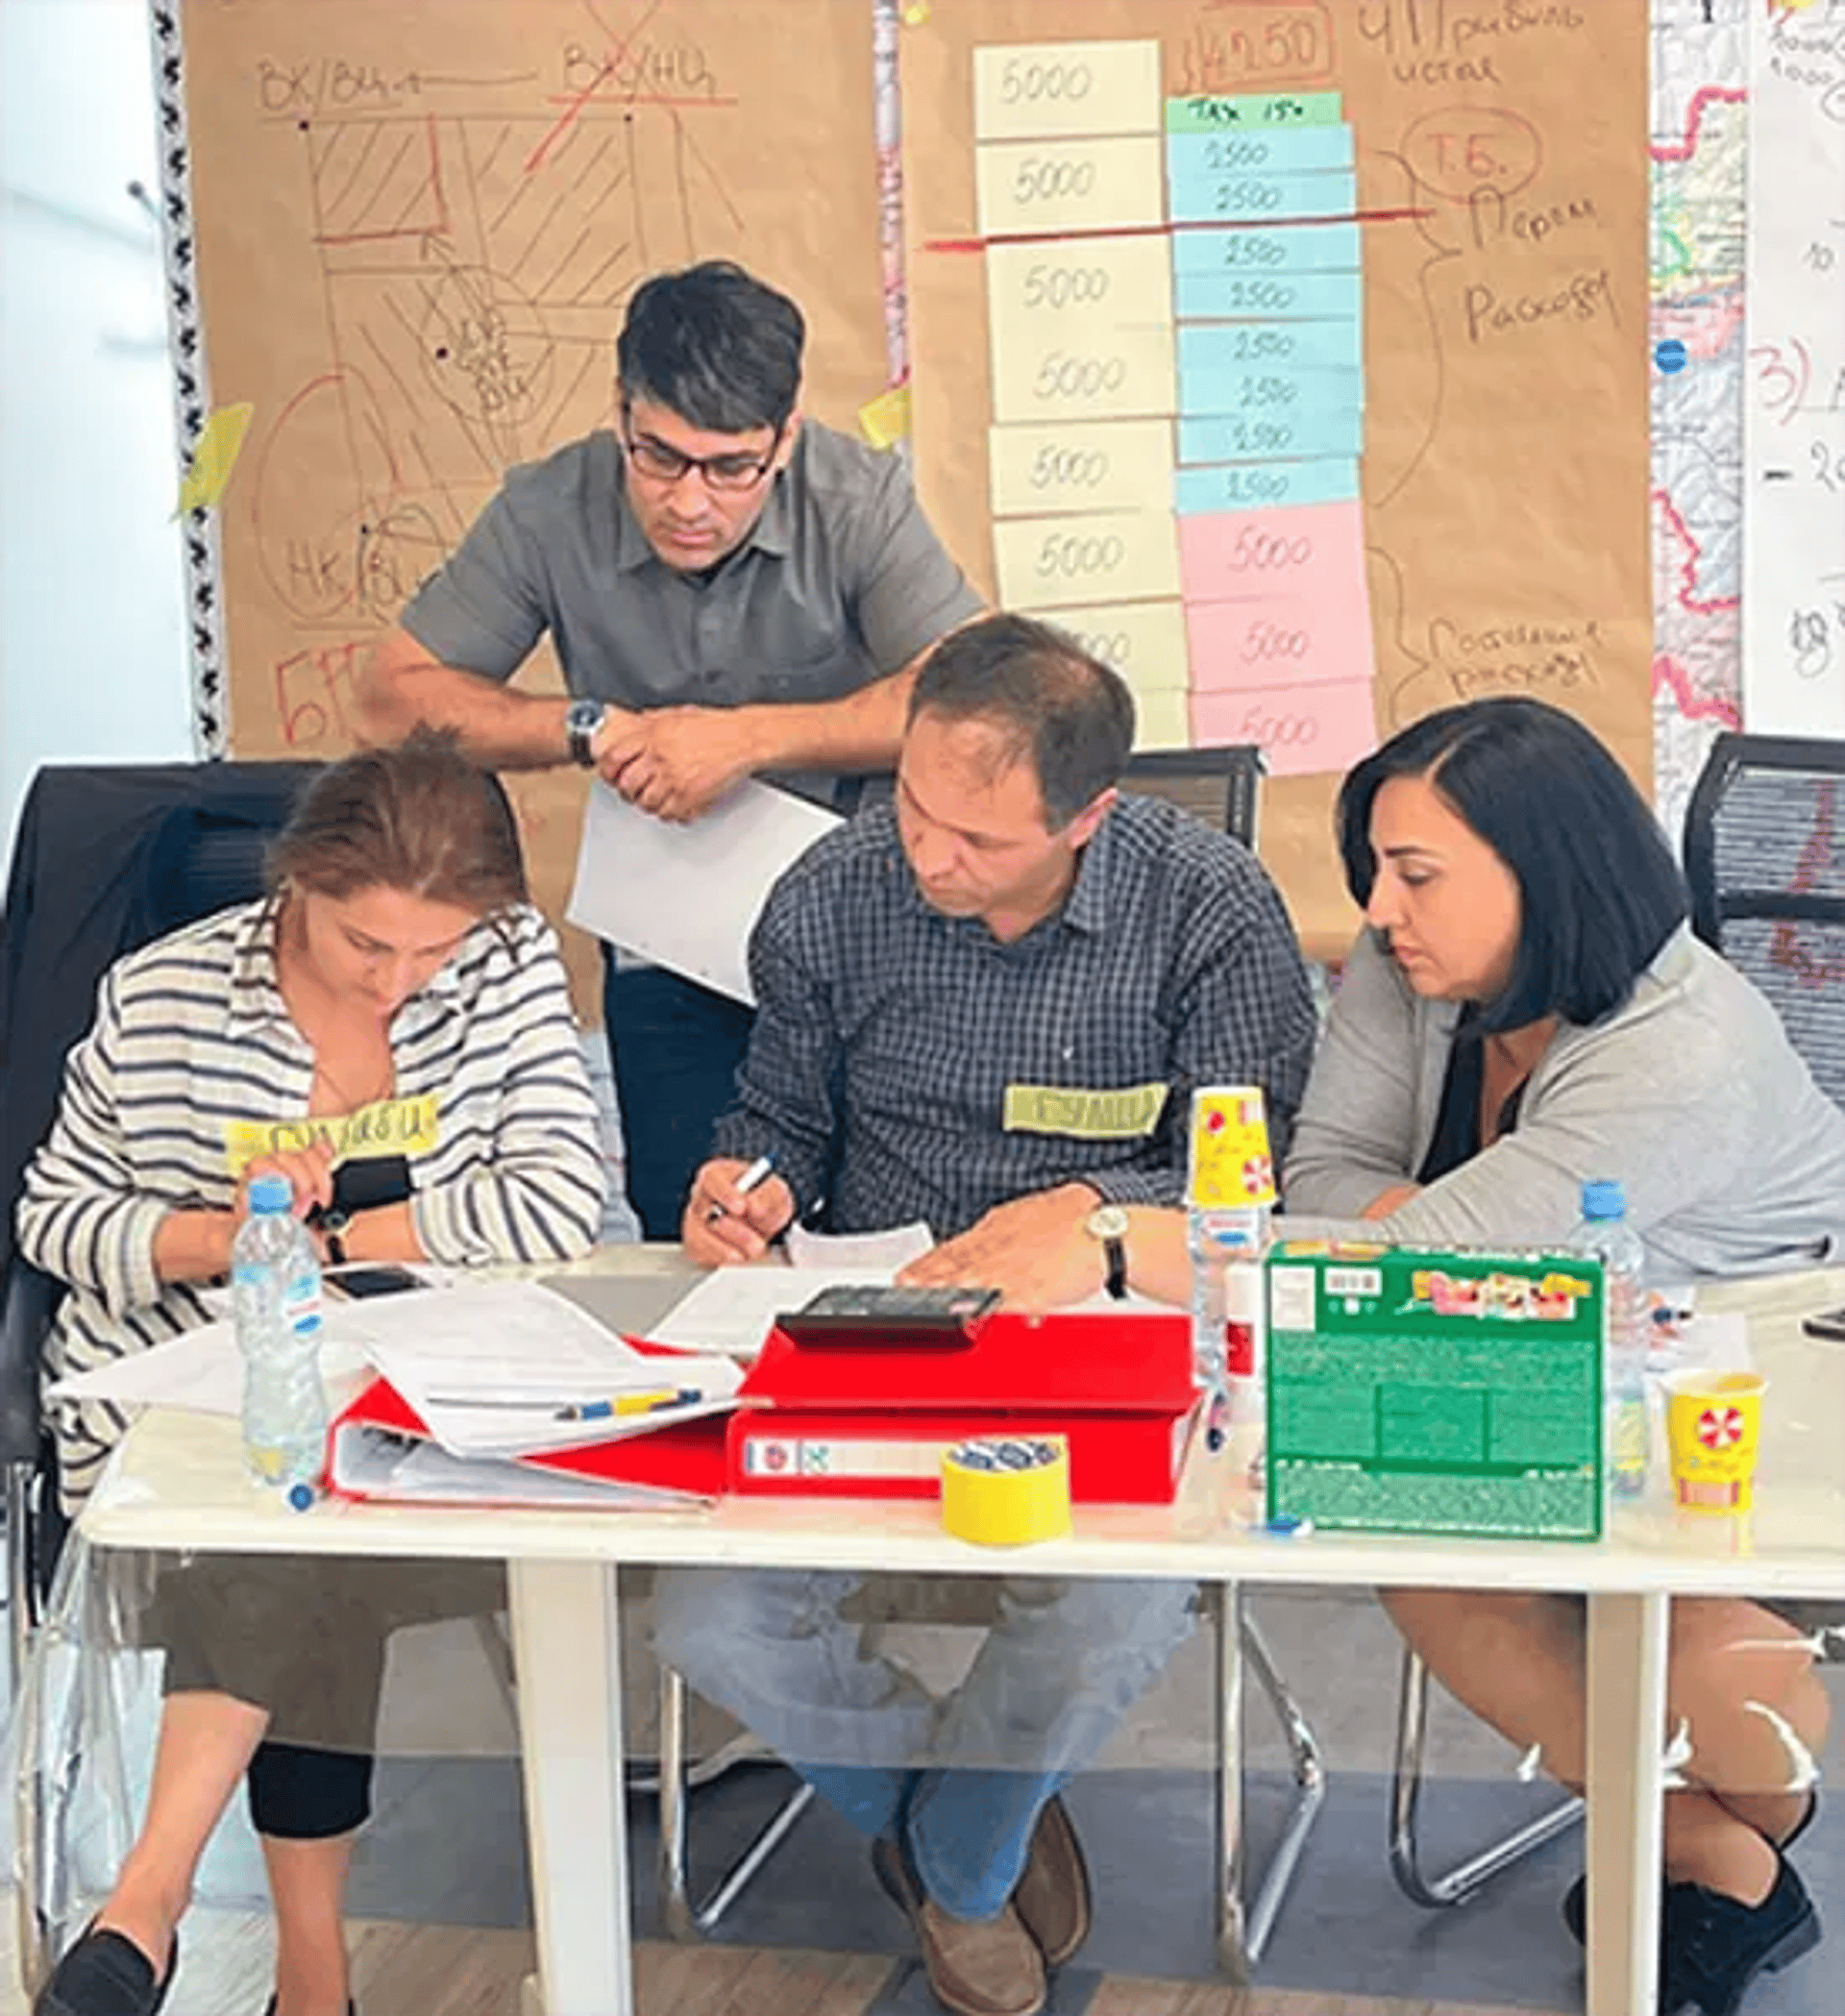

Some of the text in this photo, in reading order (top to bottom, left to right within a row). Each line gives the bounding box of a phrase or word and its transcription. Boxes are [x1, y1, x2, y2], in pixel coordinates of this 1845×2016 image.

[1001, 60, 1094, 106] 5000
[1205, 140, 1269, 168] 2500
[1013, 159, 1095, 205] 5000
[1215, 181, 1283, 212] 2500
[1224, 234, 1288, 266] 2500
[1022, 264, 1110, 310] 5000
[1231, 281, 1297, 309] 2500
[1234, 331, 1296, 361] 2500
[1032, 349, 1128, 401] 5000
[1239, 375, 1298, 407] 2500
[1232, 421, 1294, 452] 2500
[1029, 444, 1110, 489] 5000
[1034, 532, 1125, 578] 5000
[1228, 525, 1313, 574] 5000
[1239, 620, 1311, 667] 5000
[1238, 704, 1320, 749] 5000
